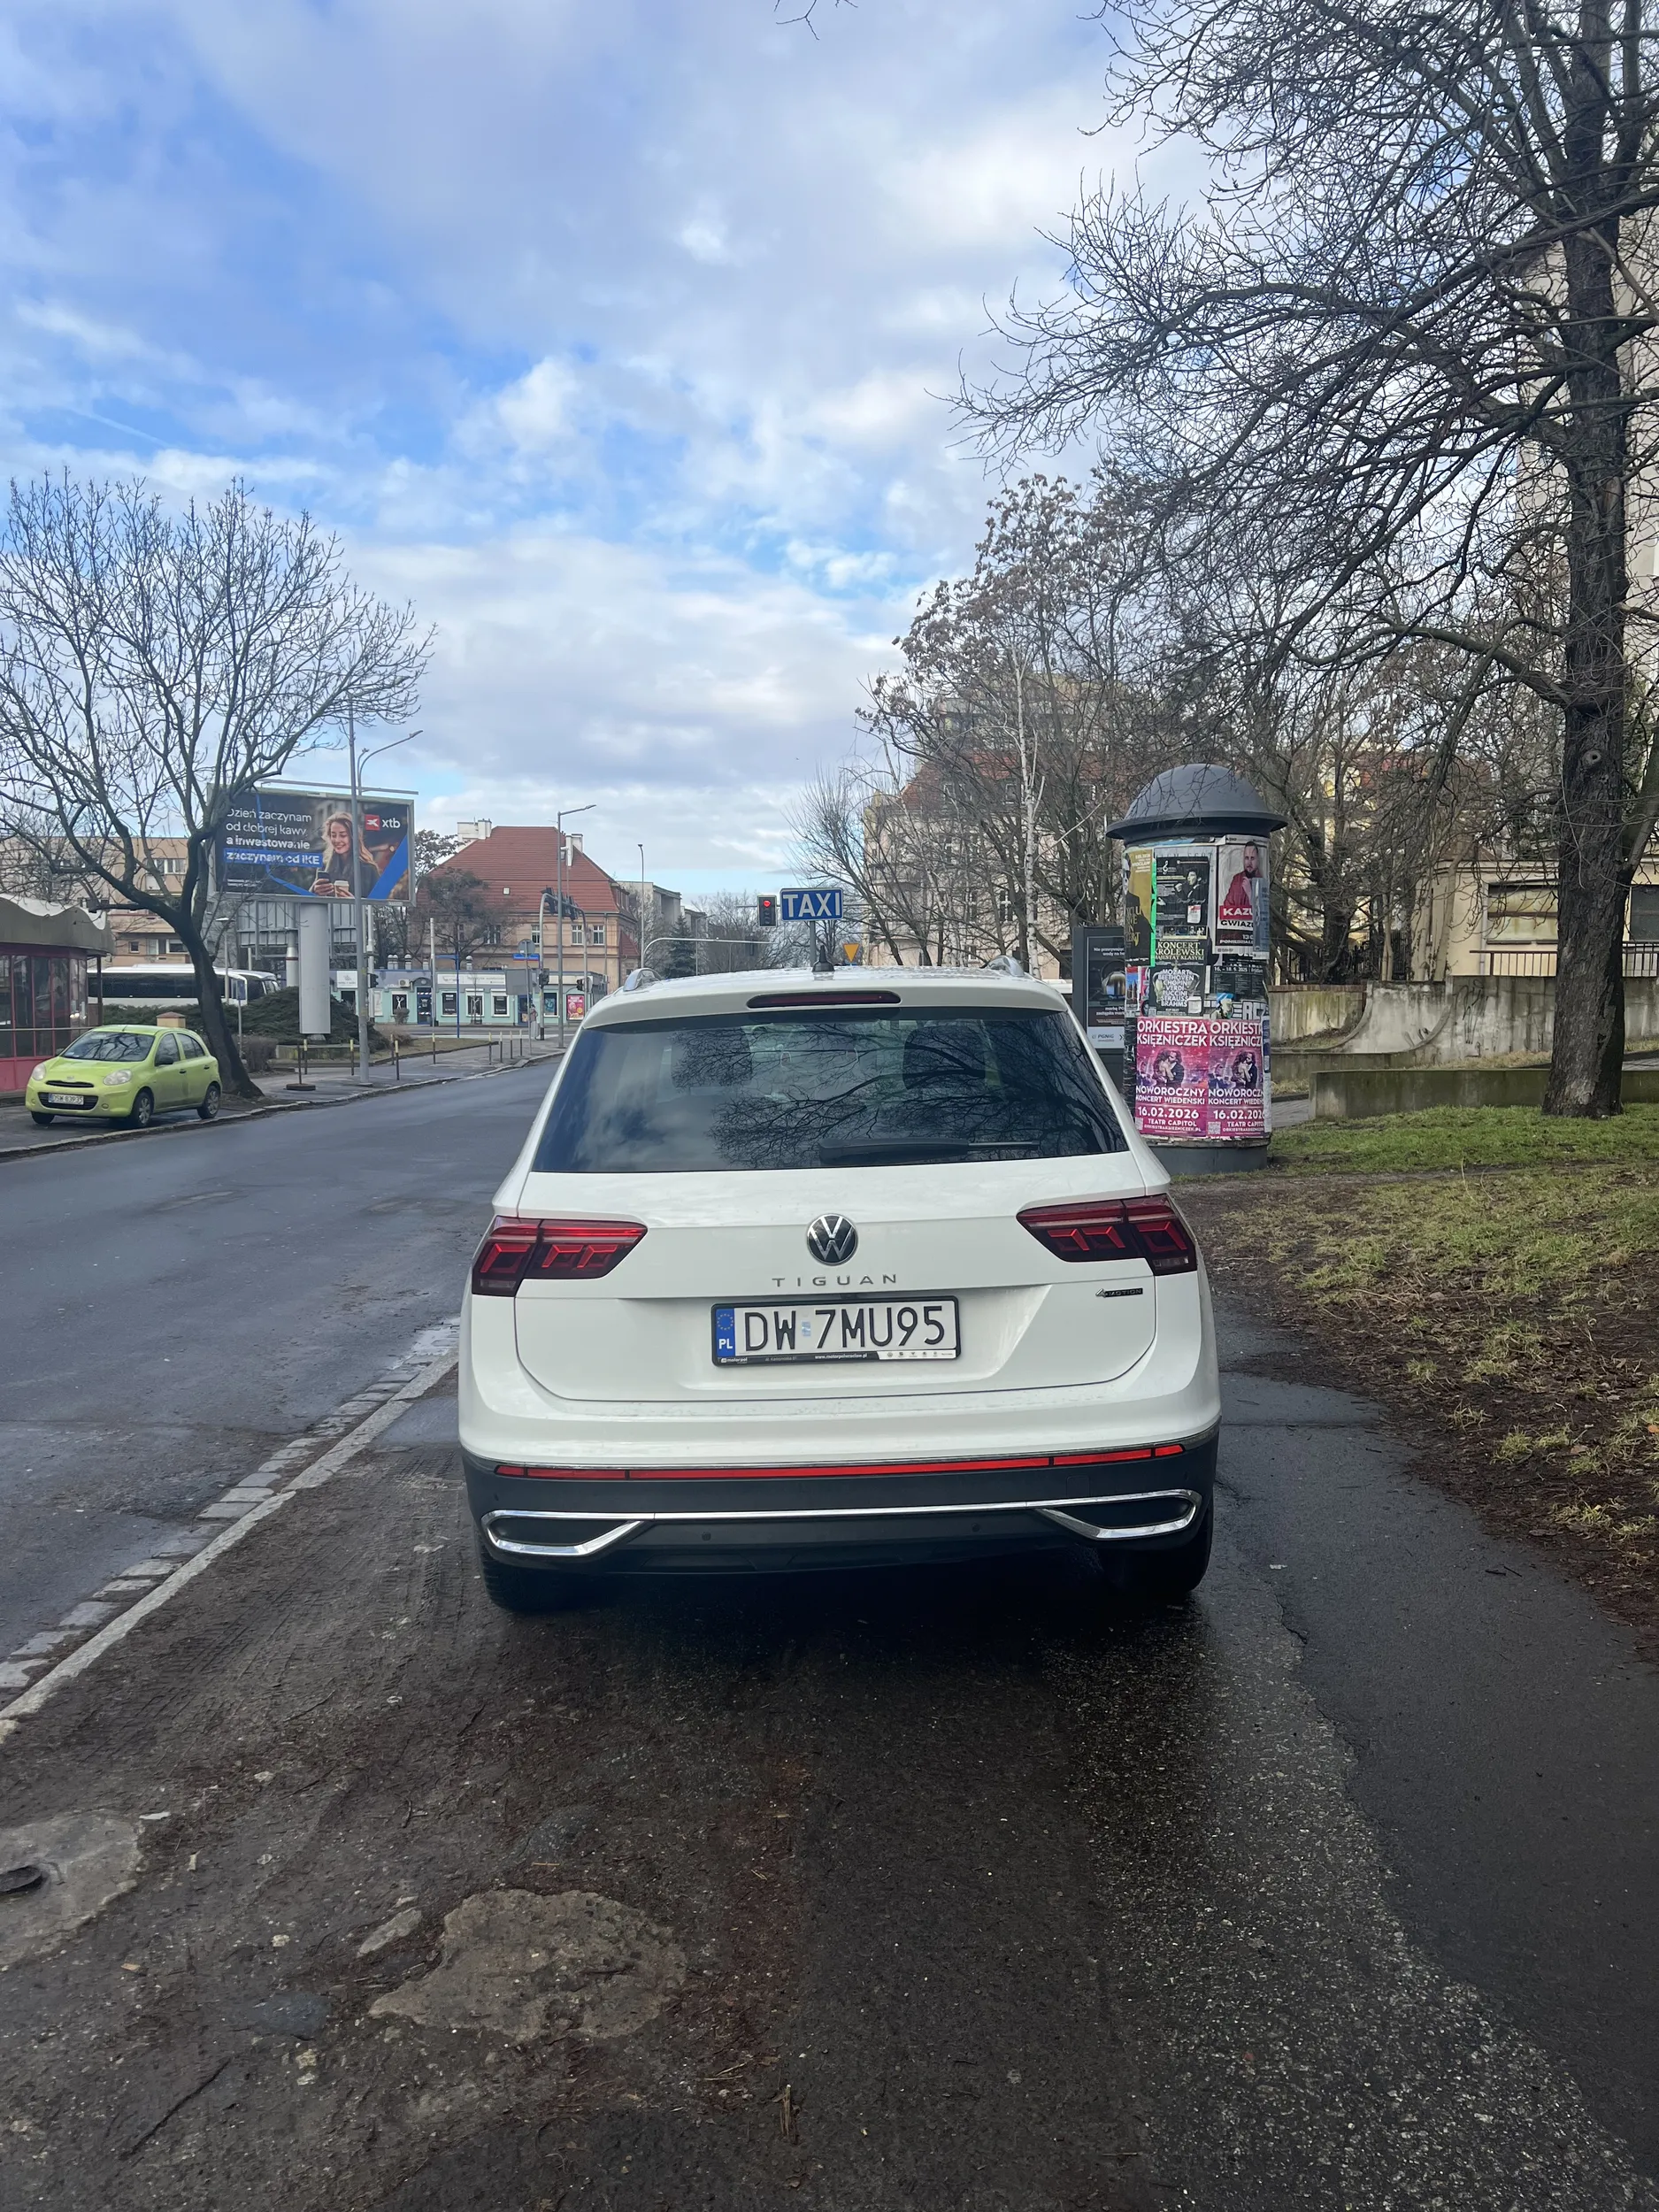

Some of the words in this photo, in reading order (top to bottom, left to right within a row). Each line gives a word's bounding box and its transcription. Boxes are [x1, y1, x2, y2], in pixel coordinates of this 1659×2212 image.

[258, 810, 311, 823] zaczynam
[382, 818, 401, 828] xtb
[226, 821, 241, 832] od
[242, 822, 278, 836] dobrej
[226, 836, 234, 845] a
[235, 834, 310, 849] inwestowanie
[227, 852, 283, 864] zaczynam
[783, 892, 841, 918] TAXI
[1137, 1020, 1208, 1034] ORKIESTRA
[1137, 1033, 1207, 1048] KSIĘŻNICZEK
[1135, 1085, 1205, 1097] NOWOROCZNY
[1135, 1094, 1163, 1103] KONCERT
[1164, 1096, 1205, 1105] WIEDEŃSKI
[1137, 1106, 1200, 1119] 16.02.2026
[772, 1274, 897, 1287] TIGUAN
[744, 1310, 796, 1352] DW
[815, 1305, 945, 1350] 7MU95
[718, 1338, 733, 1350] PL
